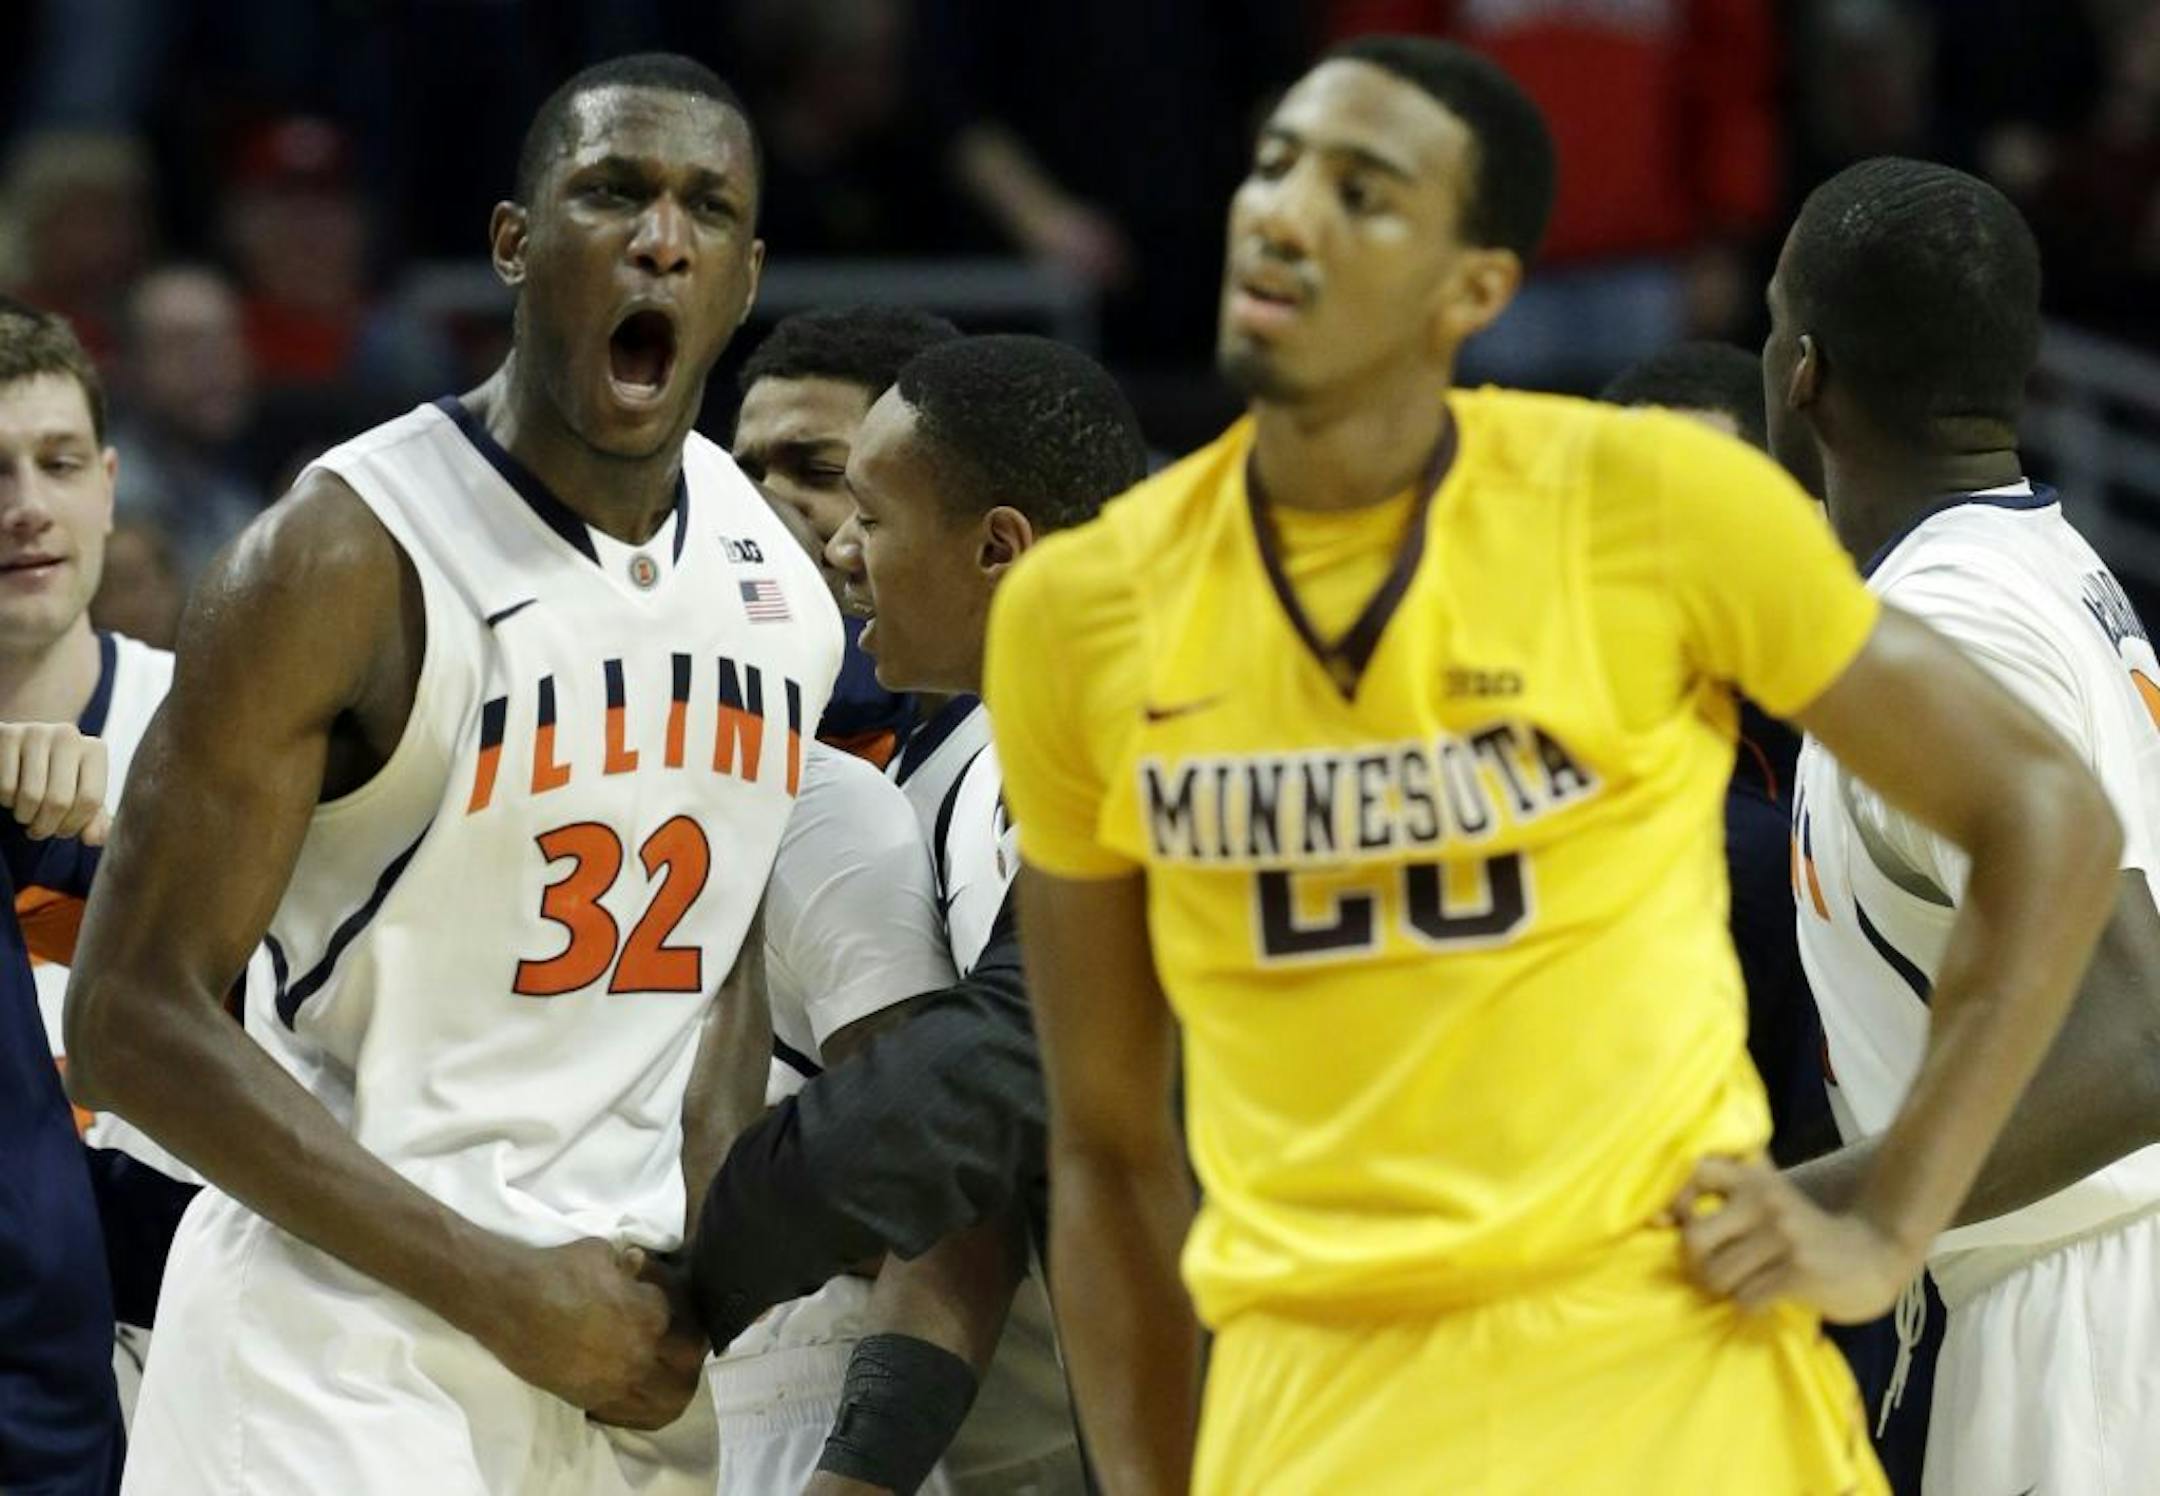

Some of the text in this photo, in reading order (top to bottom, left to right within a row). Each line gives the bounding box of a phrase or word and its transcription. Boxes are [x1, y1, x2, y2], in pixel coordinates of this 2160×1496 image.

[466, 652, 802, 816] ILLINI
[1143, 720, 1593, 862] MINNESOTA
[512, 814, 711, 996] 32
